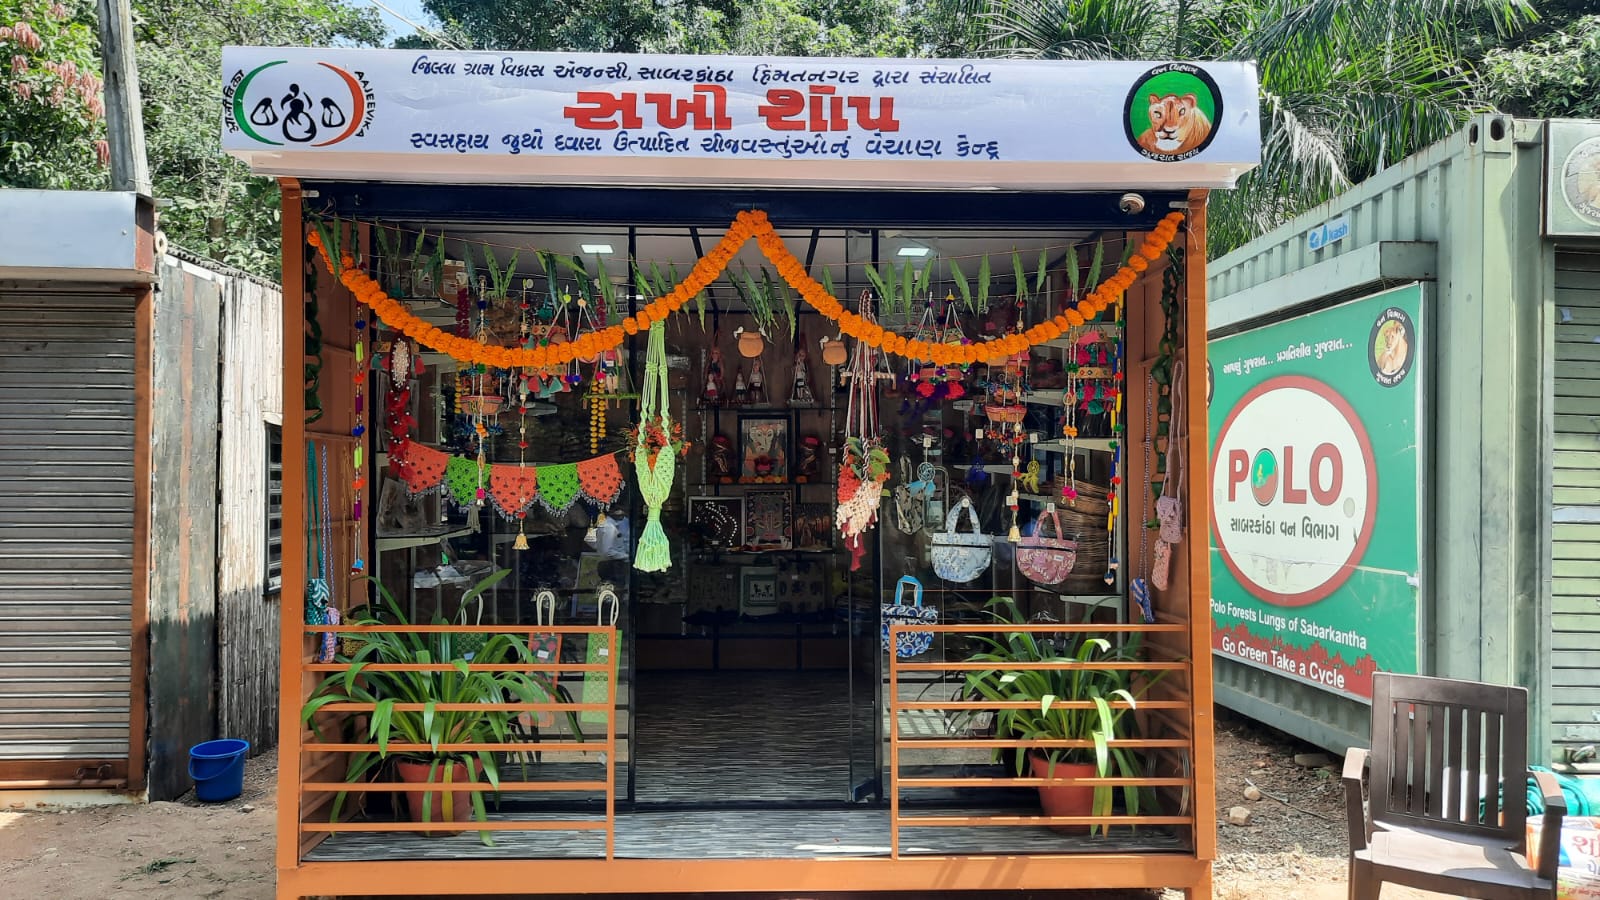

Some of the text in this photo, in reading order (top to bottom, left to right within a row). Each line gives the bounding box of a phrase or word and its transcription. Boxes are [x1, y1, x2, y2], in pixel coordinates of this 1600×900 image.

[411, 55, 456, 75] જિલ્લા
[463, 61, 495, 76] ગ્રામ
[500, 56, 545, 77] વિકાસ
[637, 65, 734, 83] સાબરકાંઠા
[919, 63, 992, 85] સંચાલિત
[223, 69, 245, 134] आजीविका
[354, 71, 376, 137] AAJEEVIKA
[563, 84, 732, 131] સખી
[410, 132, 489, 153] સ્વસહાય
[613, 130, 690, 154] ઉત્પાદિત
[865, 132, 942, 159] વેચાણ
[1228, 442, 1344, 507] POLO
[1230, 514, 1339, 541] સાબરકાંઠા વન વિભાગ
[1210, 598, 1367, 650] Polo Forests Lungs of Sabarkantha
[1222, 636, 1345, 689] Go Green Take a Cycle
